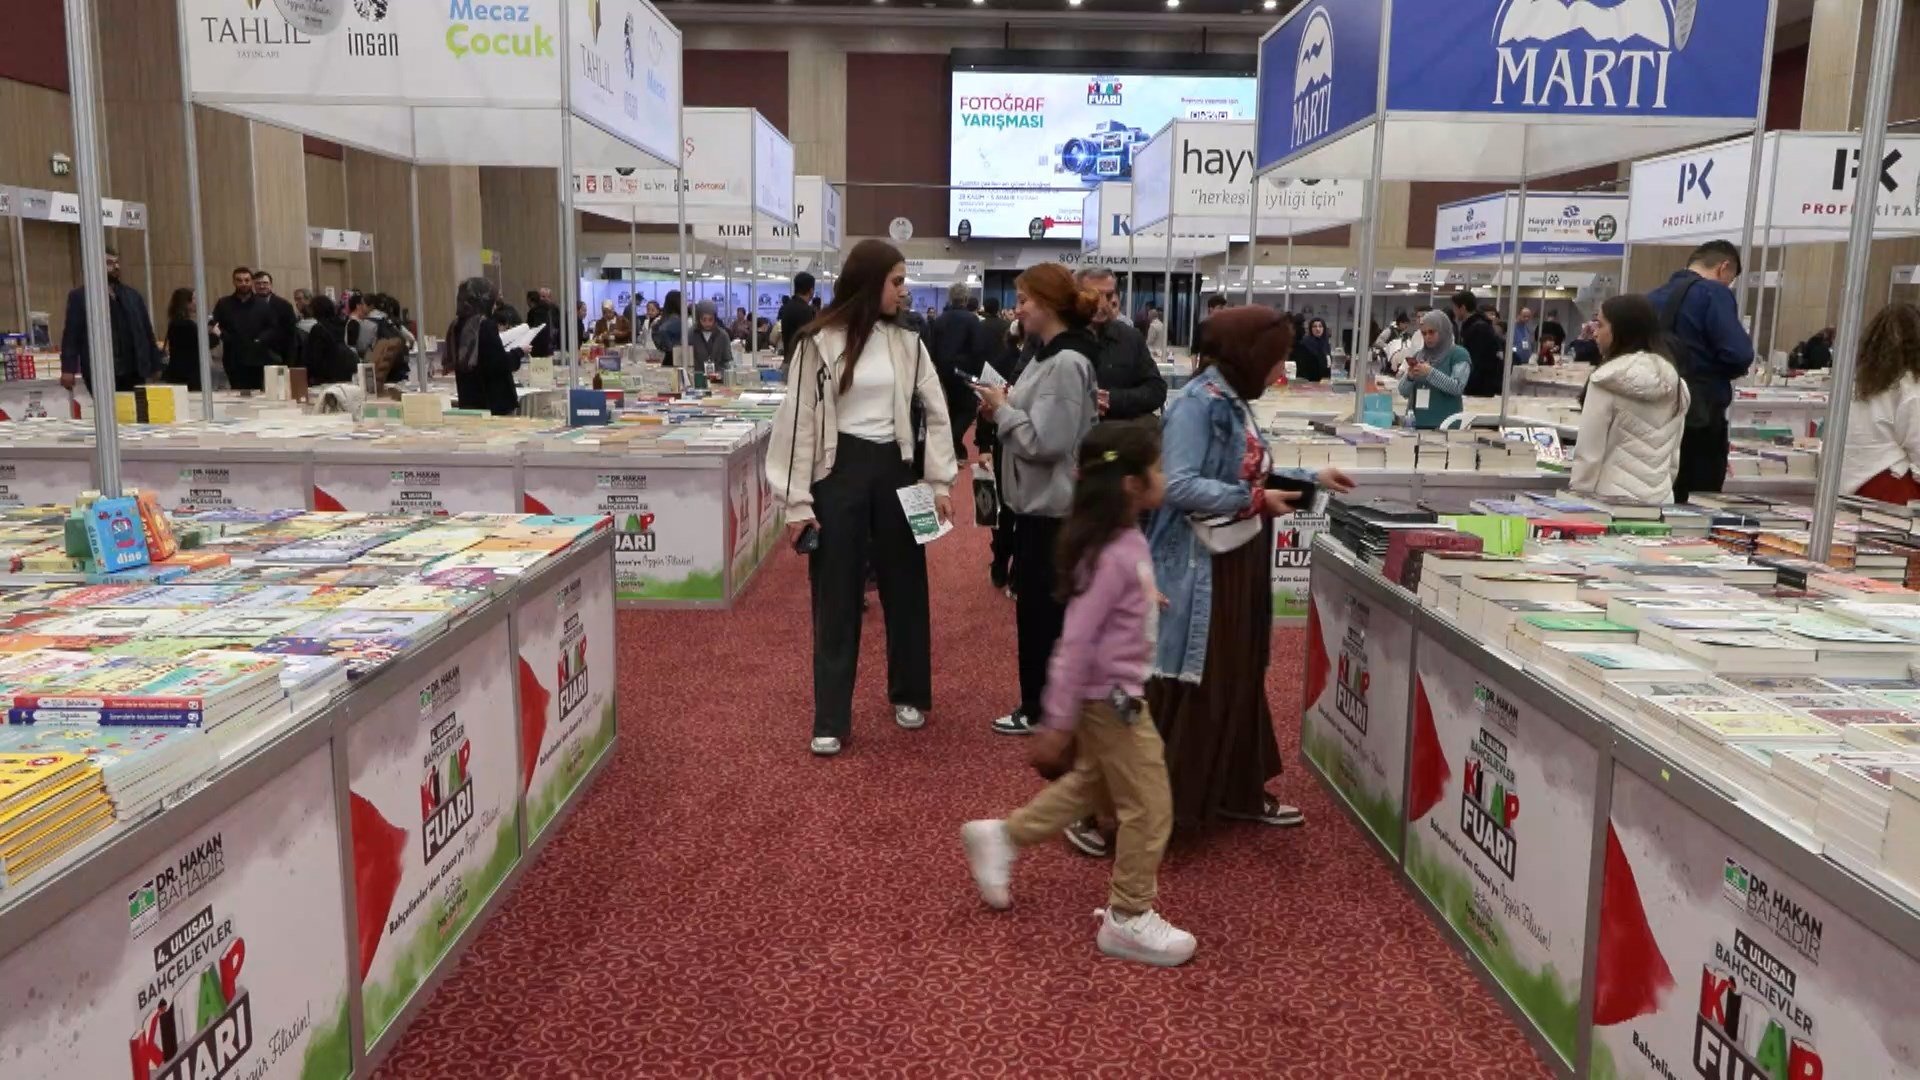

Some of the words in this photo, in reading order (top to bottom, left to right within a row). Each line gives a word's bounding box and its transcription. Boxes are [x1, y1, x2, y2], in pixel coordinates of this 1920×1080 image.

[450, 0, 529, 21] Mecaz
[348, 27, 399, 56] insan
[445, 23, 555, 58] Çocuk
[960, 93, 1045, 112] FOTOĞRAF
[1089, 95, 1121, 105] FUARI
[1492, 46, 1673, 108] MARTI
[961, 113, 1044, 131] YARIŞMASI
[1291, 82, 1331, 150] MARTI
[1112, 214, 1131, 237] K
[1802, 203, 1855, 215] PROF
[117, 551, 142, 565] dino
[615, 535, 652, 550] ARI
[1278, 551, 1311, 567] FUA
[559, 668, 587, 719] FUARI
[1337, 685, 1367, 732] FUARI
[420, 737, 471, 822] KİTAP
[1463, 756, 1520, 829] KİTAP
[425, 784, 472, 859] FUARI
[1463, 800, 1514, 873] FUARI
[156, 868, 178, 891] DR.
[179, 832, 223, 876] HAKAN
[157, 851, 224, 912] BAHADIR
[1747, 890, 1822, 958] BAHADIR
[1749, 874, 1770, 905] DR.
[1773, 889, 1823, 940] HAKAN
[138, 919, 232, 1010] BAHÇELİEVLER
[156, 948, 169, 966] 4.
[170, 910, 212, 953] ULUSAL
[1735, 936, 1748, 954] 4.
[1750, 948, 1794, 992] ULUSAL
[129, 937, 246, 1080] KİTAP
[1715, 941, 1814, 1035] BAHÇELİEVLER
[267, 1000, 311, 1064] Filistin!
[1700, 963, 1824, 1080] KİTAP
